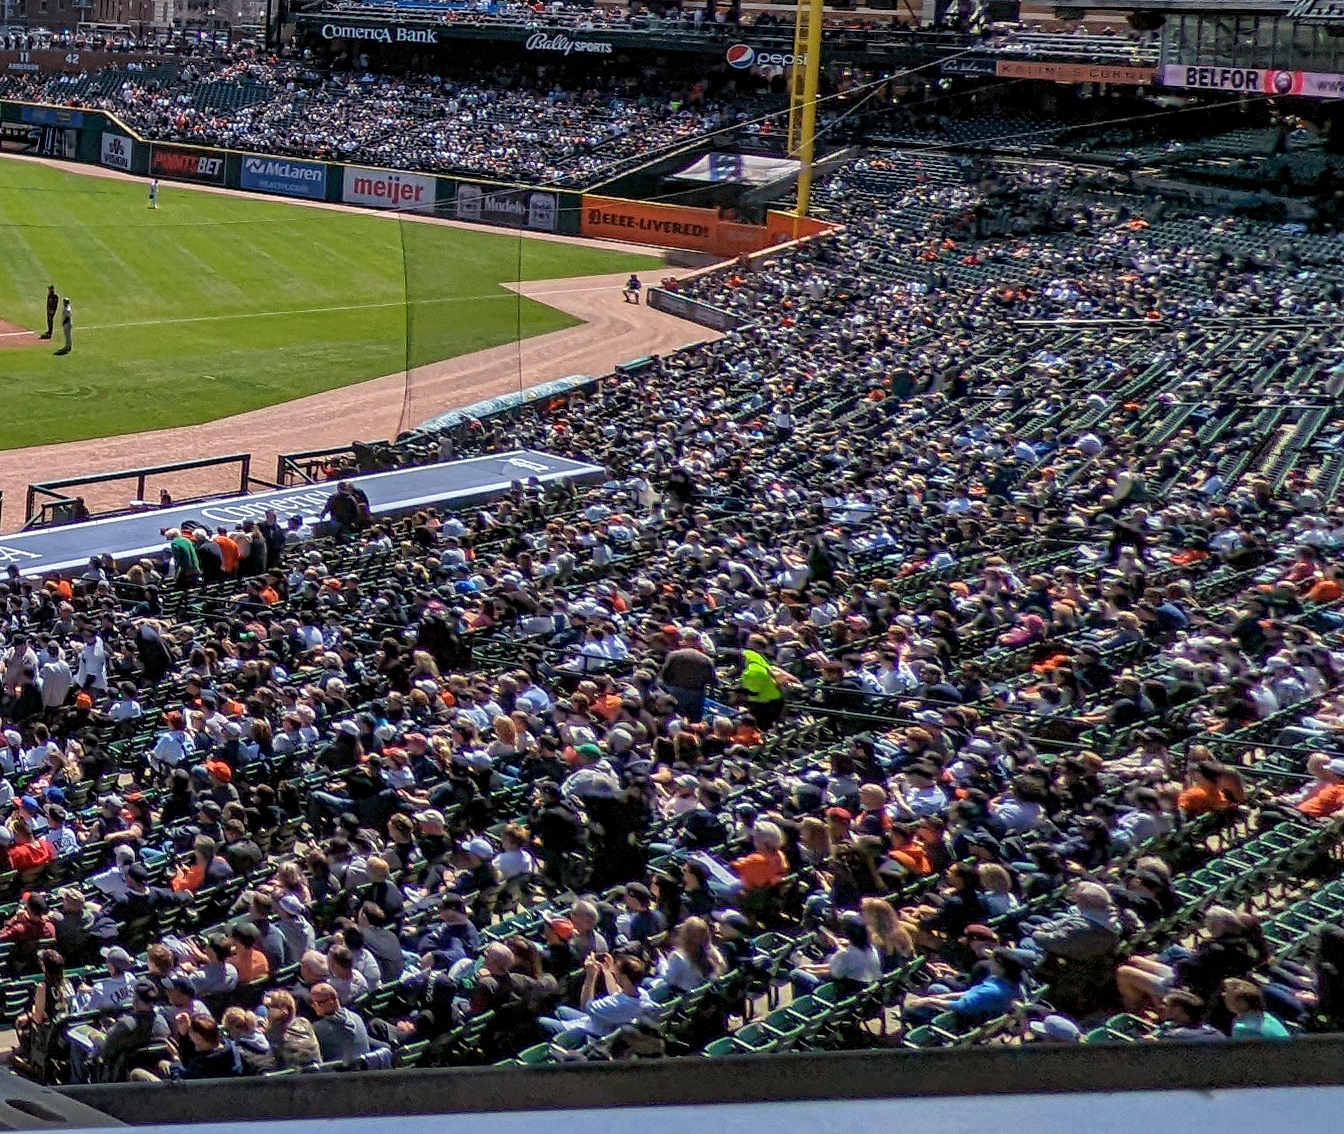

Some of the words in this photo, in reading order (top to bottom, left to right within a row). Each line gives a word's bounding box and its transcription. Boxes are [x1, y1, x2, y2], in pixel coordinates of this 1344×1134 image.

[396, 27, 439, 44] Bank
[525, 32, 575, 57] Bally
[574, 41, 613, 54] SPORTS
[19, 51, 30, 63] 11
[64, 53, 80, 64] 42
[757, 52, 808, 67] pepsi
[1186, 66, 1260, 91] BELFOR
[265, 161, 323, 182] McLaren
[353, 174, 424, 205] meijer
